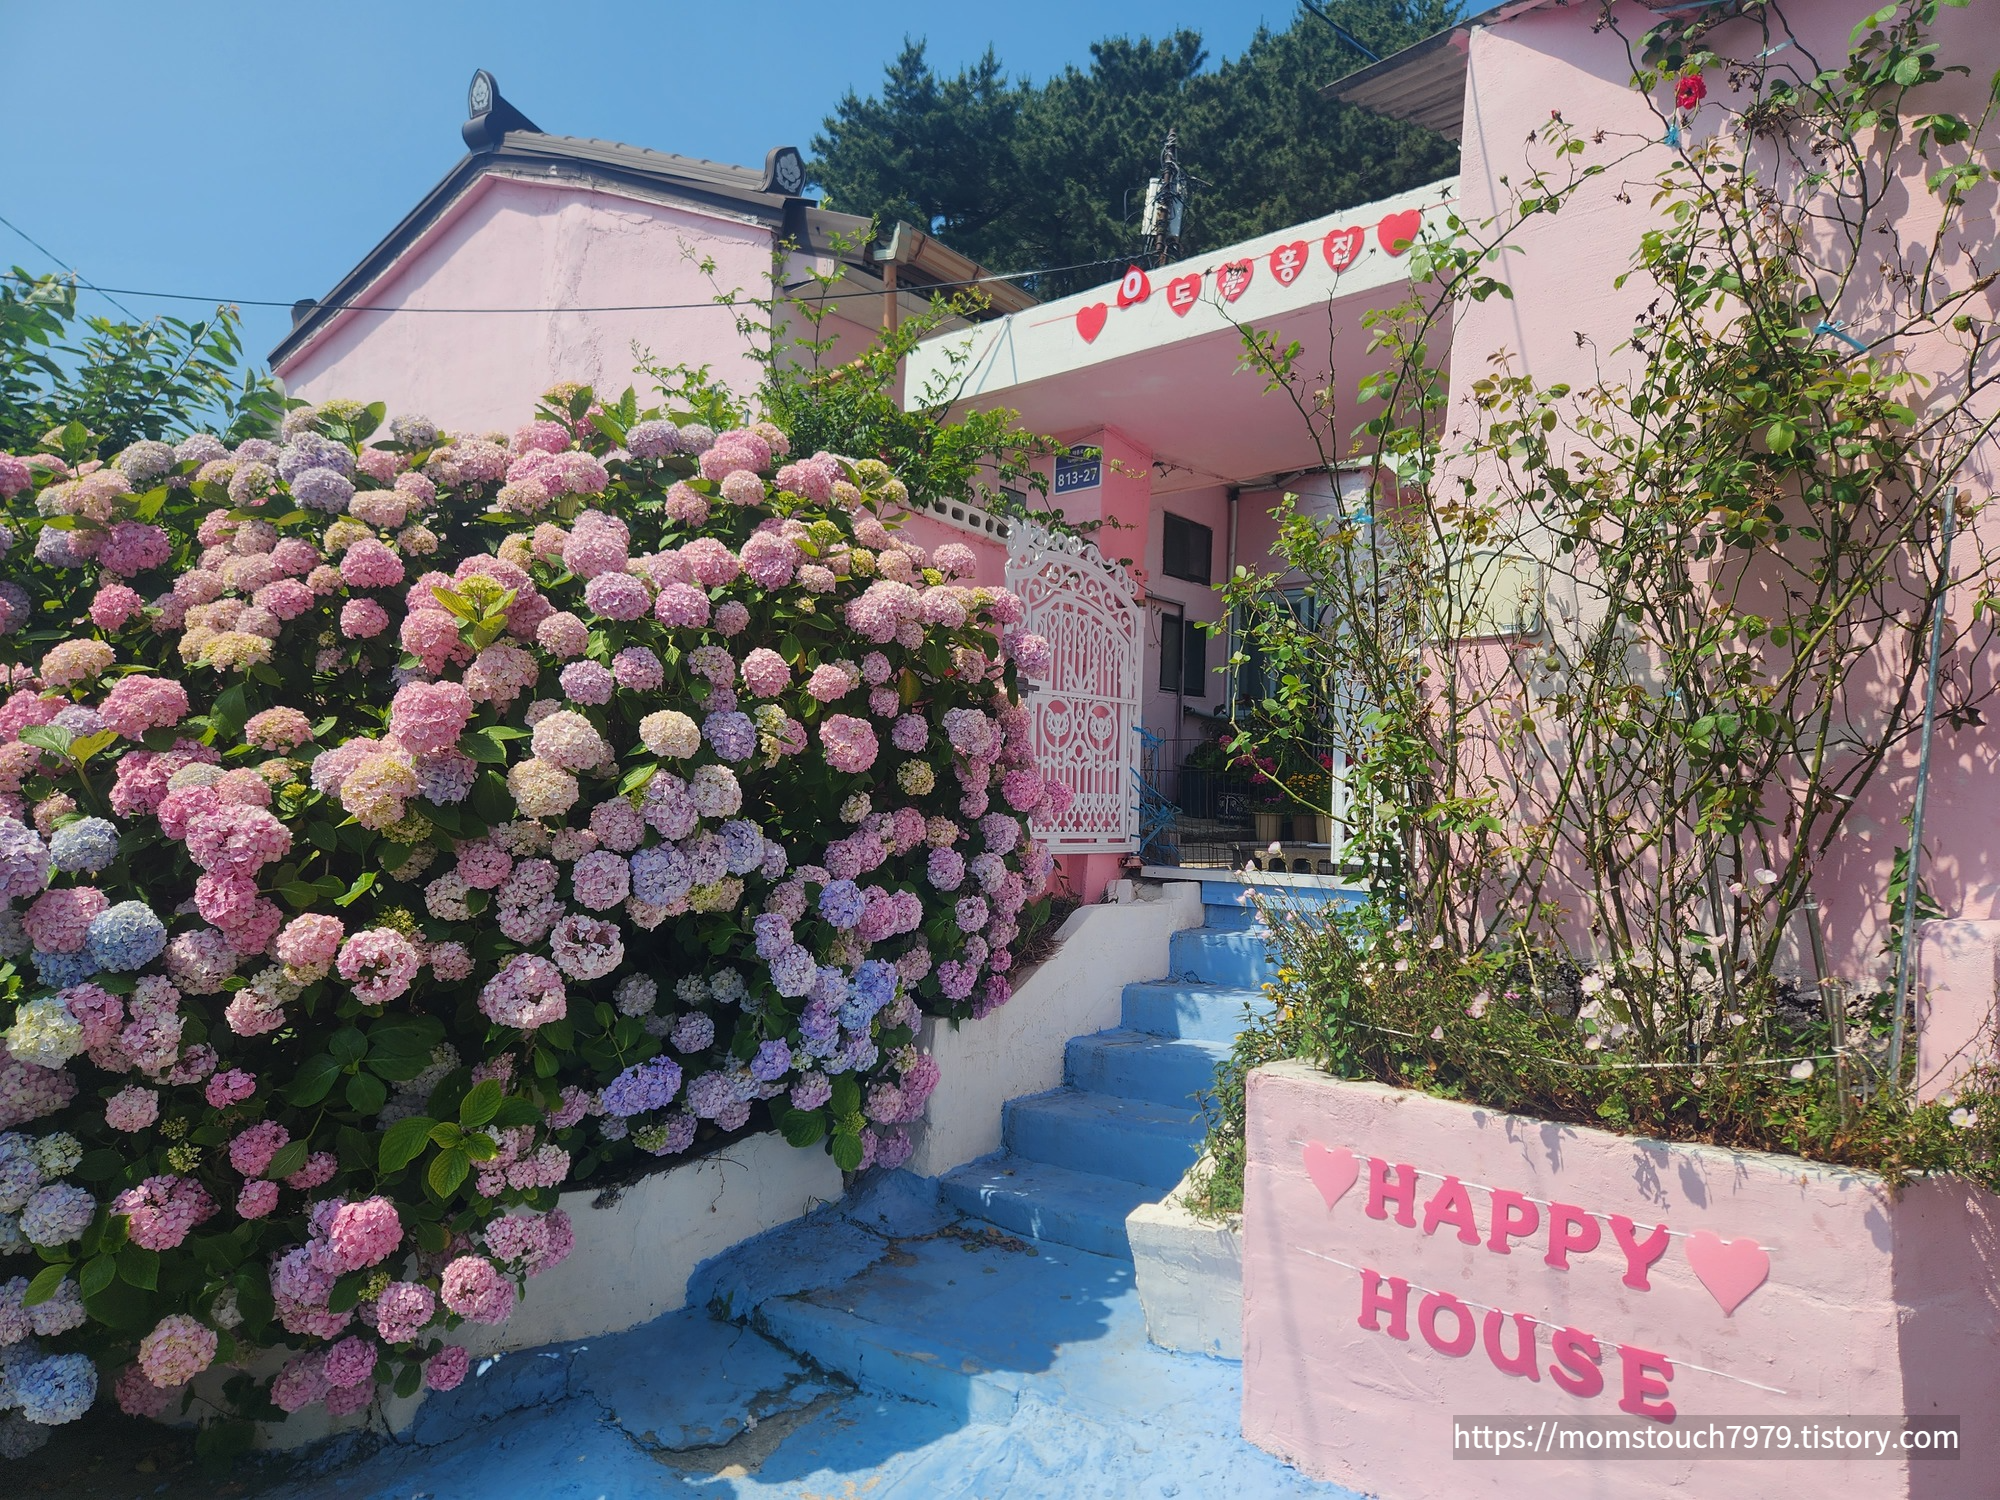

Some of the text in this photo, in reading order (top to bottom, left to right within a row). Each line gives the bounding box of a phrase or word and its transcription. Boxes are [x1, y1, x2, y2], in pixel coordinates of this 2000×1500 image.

[1058, 467, 1098, 487] 813-27
[1365, 1156, 1670, 1292] HAPPY
[1357, 1267, 1677, 1425] HOUSE
